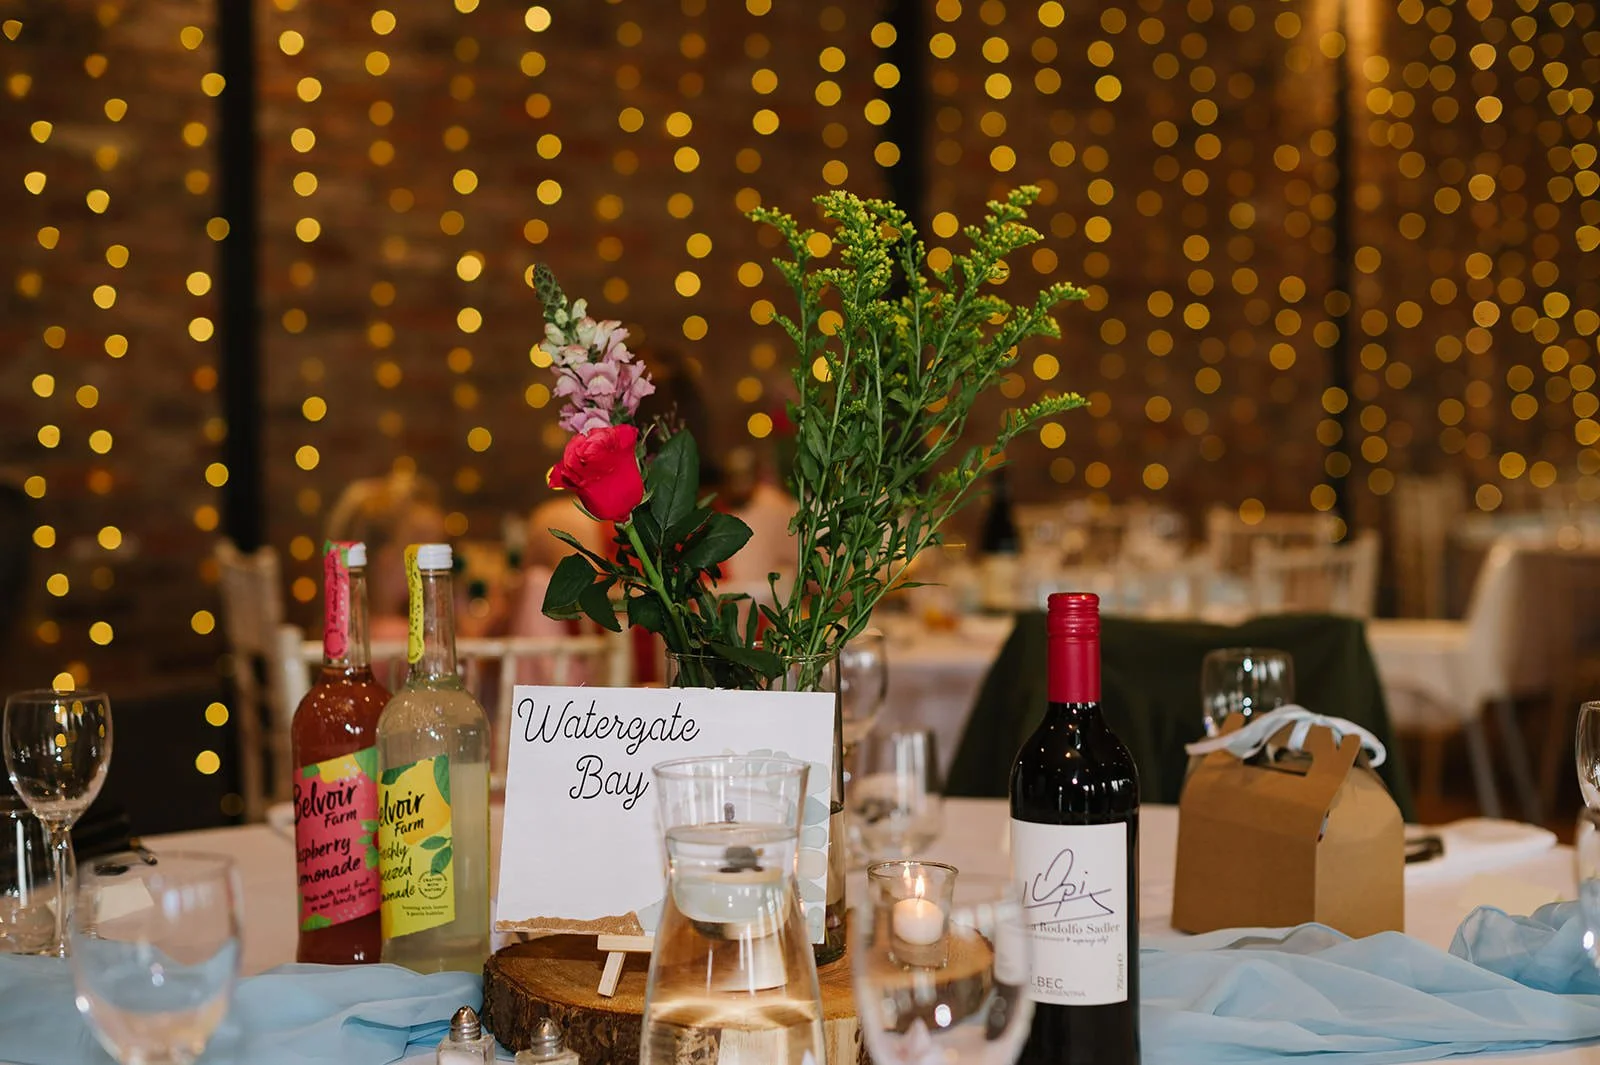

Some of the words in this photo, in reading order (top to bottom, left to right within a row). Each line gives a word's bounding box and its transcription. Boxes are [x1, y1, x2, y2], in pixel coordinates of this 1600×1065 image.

[517, 698, 701, 755] Watergate
[569, 754, 650, 810] Bay
[294, 781, 357, 825] Belvoir
[380, 790, 425, 827] elvoir
[324, 808, 357, 828] Farm
[395, 818, 424, 837] Farm
[1039, 922, 1083, 935] Rodolfo
[1086, 922, 1120, 934] Sadler
[1030, 975, 1064, 989] LBEC
